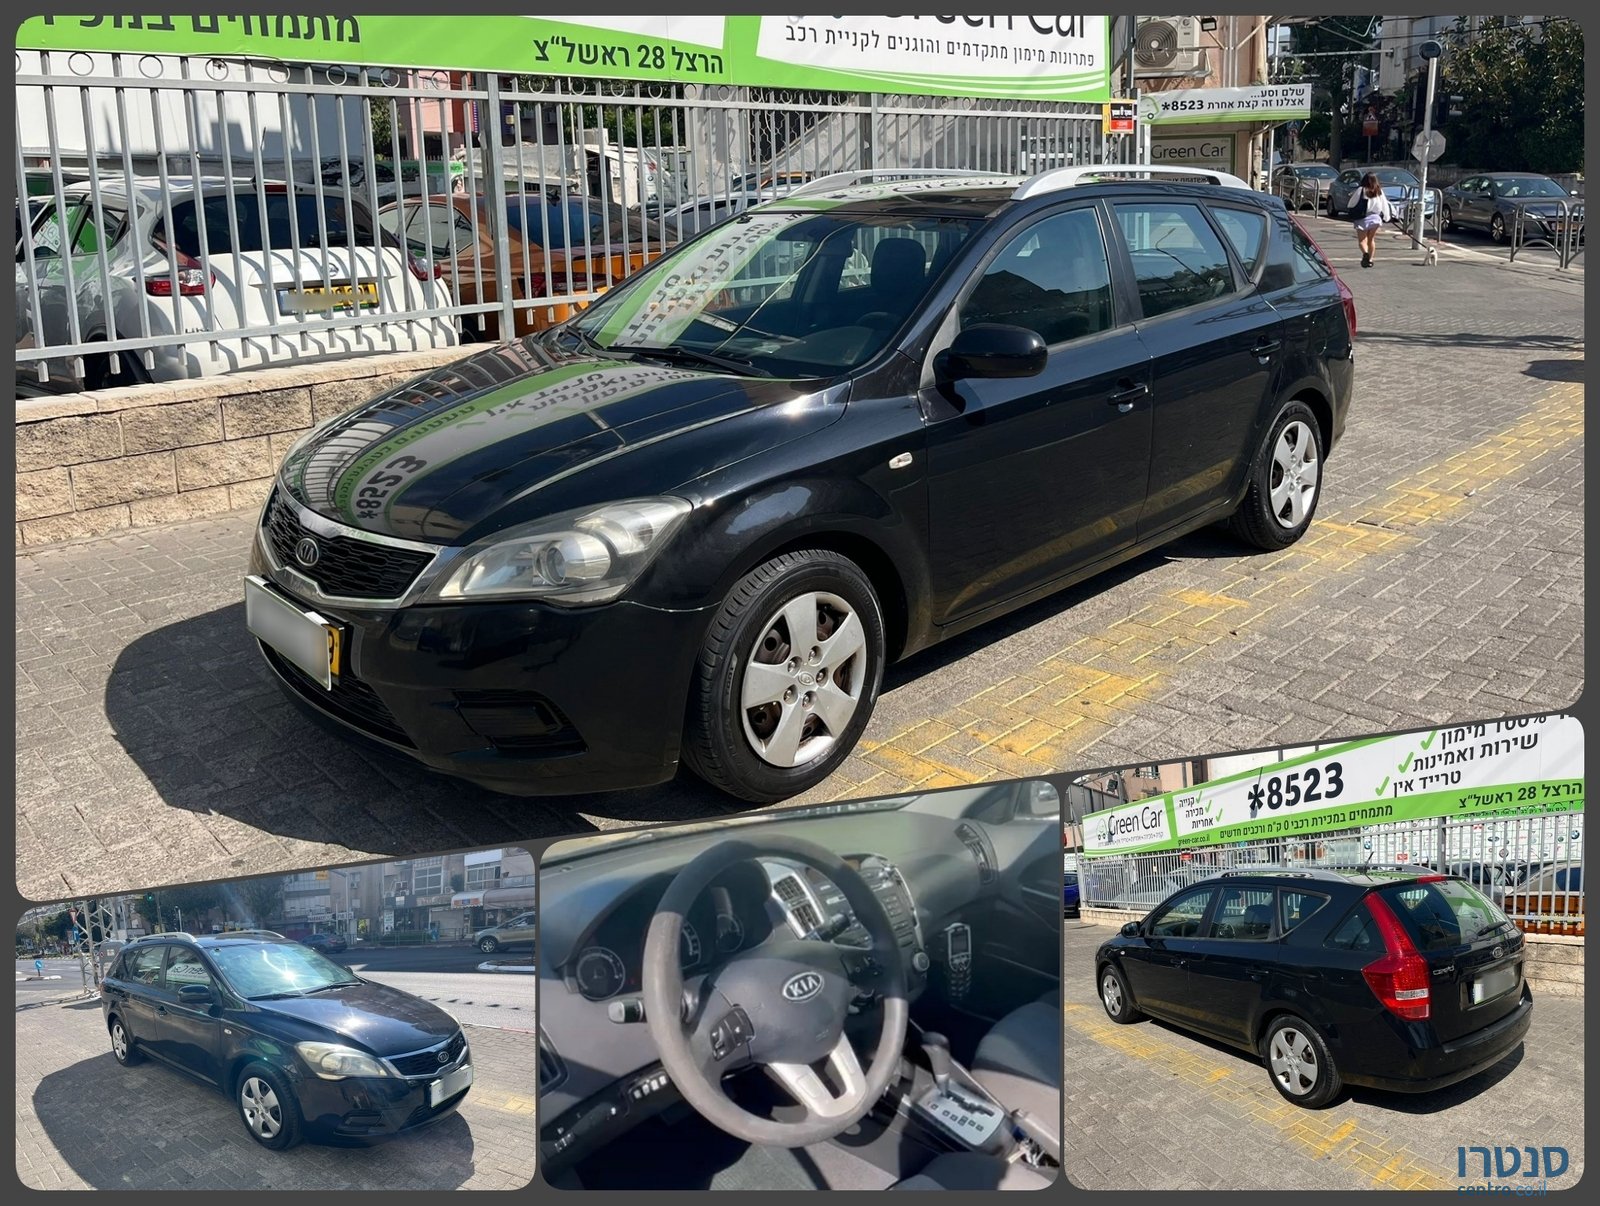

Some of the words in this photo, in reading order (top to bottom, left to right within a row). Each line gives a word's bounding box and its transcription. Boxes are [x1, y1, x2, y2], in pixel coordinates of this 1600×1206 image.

[785, 25, 817, 43] רכב
[825, 29, 880, 52] לקניית
[888, 35, 940, 54] והוגנים
[947, 41, 1008, 62] מתקדמים
[637, 44, 665, 70] 28
[671, 46, 724, 74] הרצל
[1013, 47, 1045, 64] מימון
[1050, 50, 1094, 66] פתרונות
[1281, 88, 1305, 97] שלם
[1207, 102, 1235, 110] אחרת
[1237, 100, 1258, 110] קצת
[1262, 99, 1273, 107] זה
[1276, 97, 1305, 107] אצלנו
[1151, 145, 1196, 159] Green
[1200, 143, 1226, 157] Car
[1441, 724, 1485, 750] מימון
[1480, 733, 1538, 758] שירות
[1412, 747, 1474, 772] ואמינות
[1418, 770, 1461, 789] טרייד
[1393, 778, 1413, 798] אין
[1518, 786, 1537, 801] 28
[1541, 783, 1582, 798] הרצל
[1179, 797, 1195, 808] קנייה
[1185, 806, 1204, 818] מכירה
[1311, 813, 1346, 827] במכירת
[1350, 804, 1393, 821] מתמחים
[1108, 815, 1139, 836] Green
[1142, 806, 1163, 830] Car
[1192, 817, 1214, 829] אחריות
[1291, 818, 1309, 830] רכבי
[1220, 827, 1242, 839] חדשים
[1243, 824, 1266, 836] ורכבים
[1178, 834, 1210, 848] green-car.co.il
[789, 976, 818, 997] KIA
